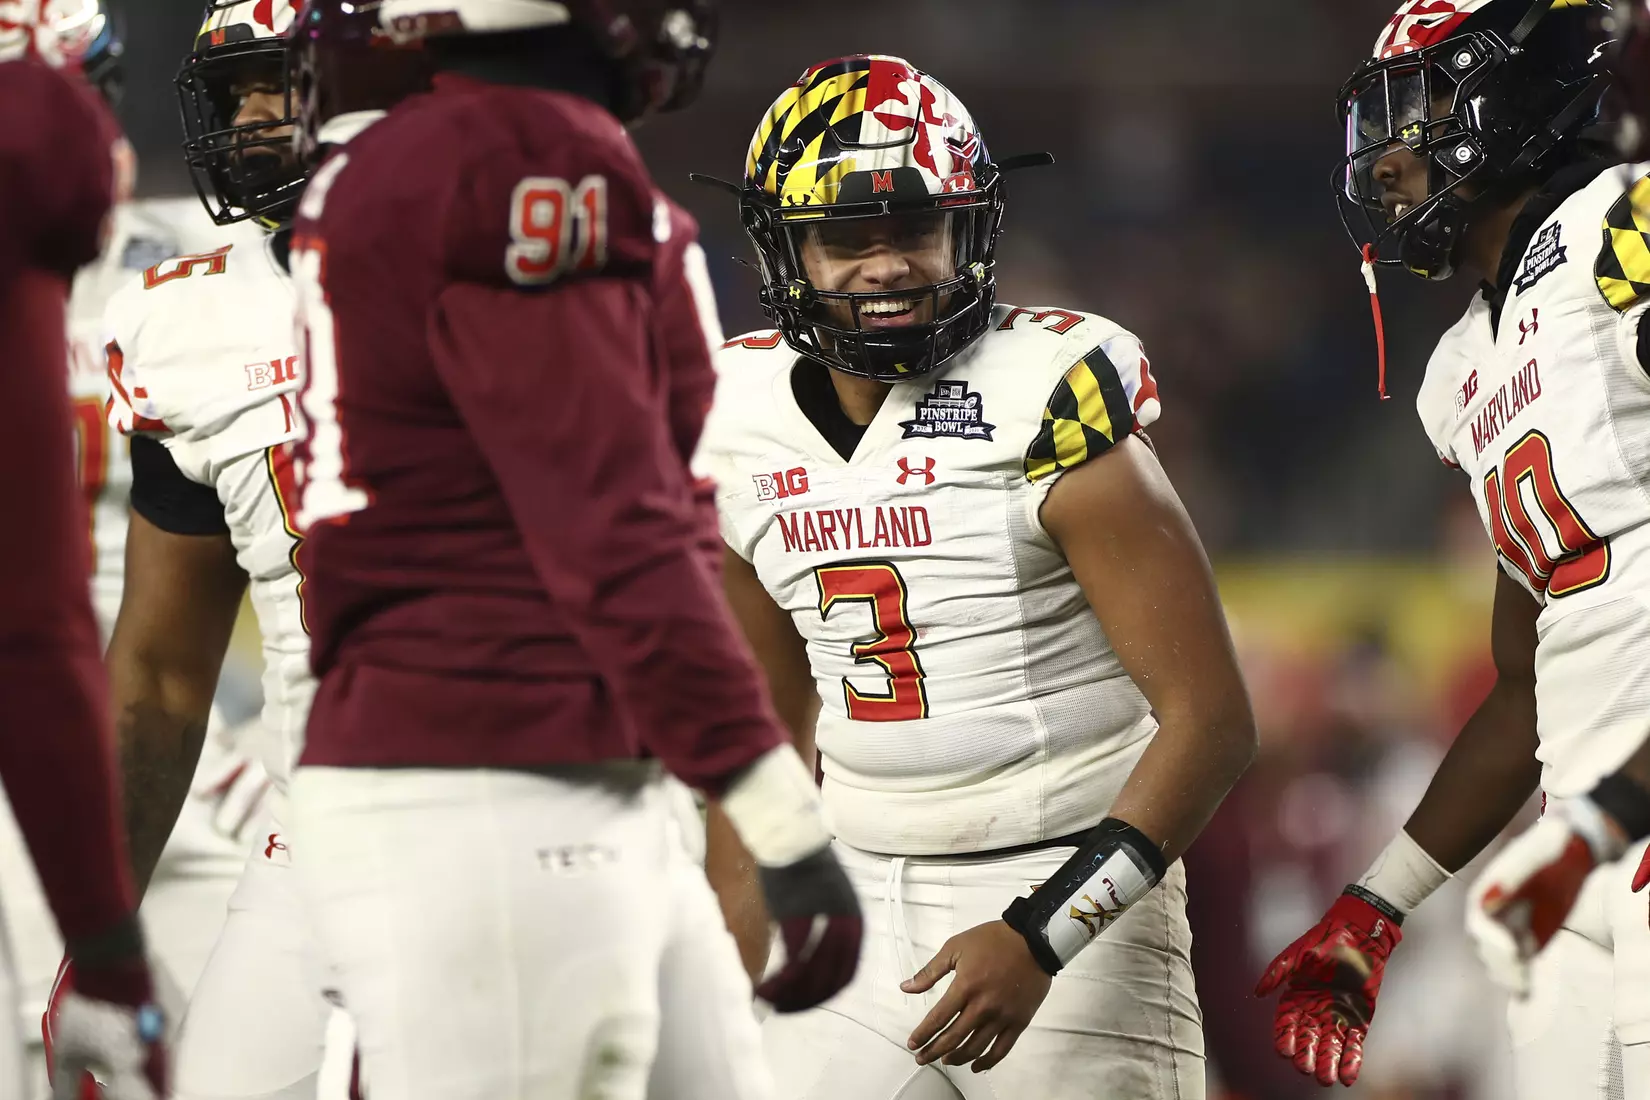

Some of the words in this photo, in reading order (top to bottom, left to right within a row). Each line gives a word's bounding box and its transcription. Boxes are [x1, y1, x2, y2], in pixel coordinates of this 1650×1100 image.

[871, 170, 894, 193] M
[505, 174, 608, 285] 91
[920, 407, 978, 421] PINSTRIPE
[935, 421, 963, 433] BOWL
[1471, 358, 1542, 461] MARYLAND
[775, 506, 932, 553] MARYLAND
[1484, 428, 1612, 599] 10
[813, 560, 929, 722] 3
